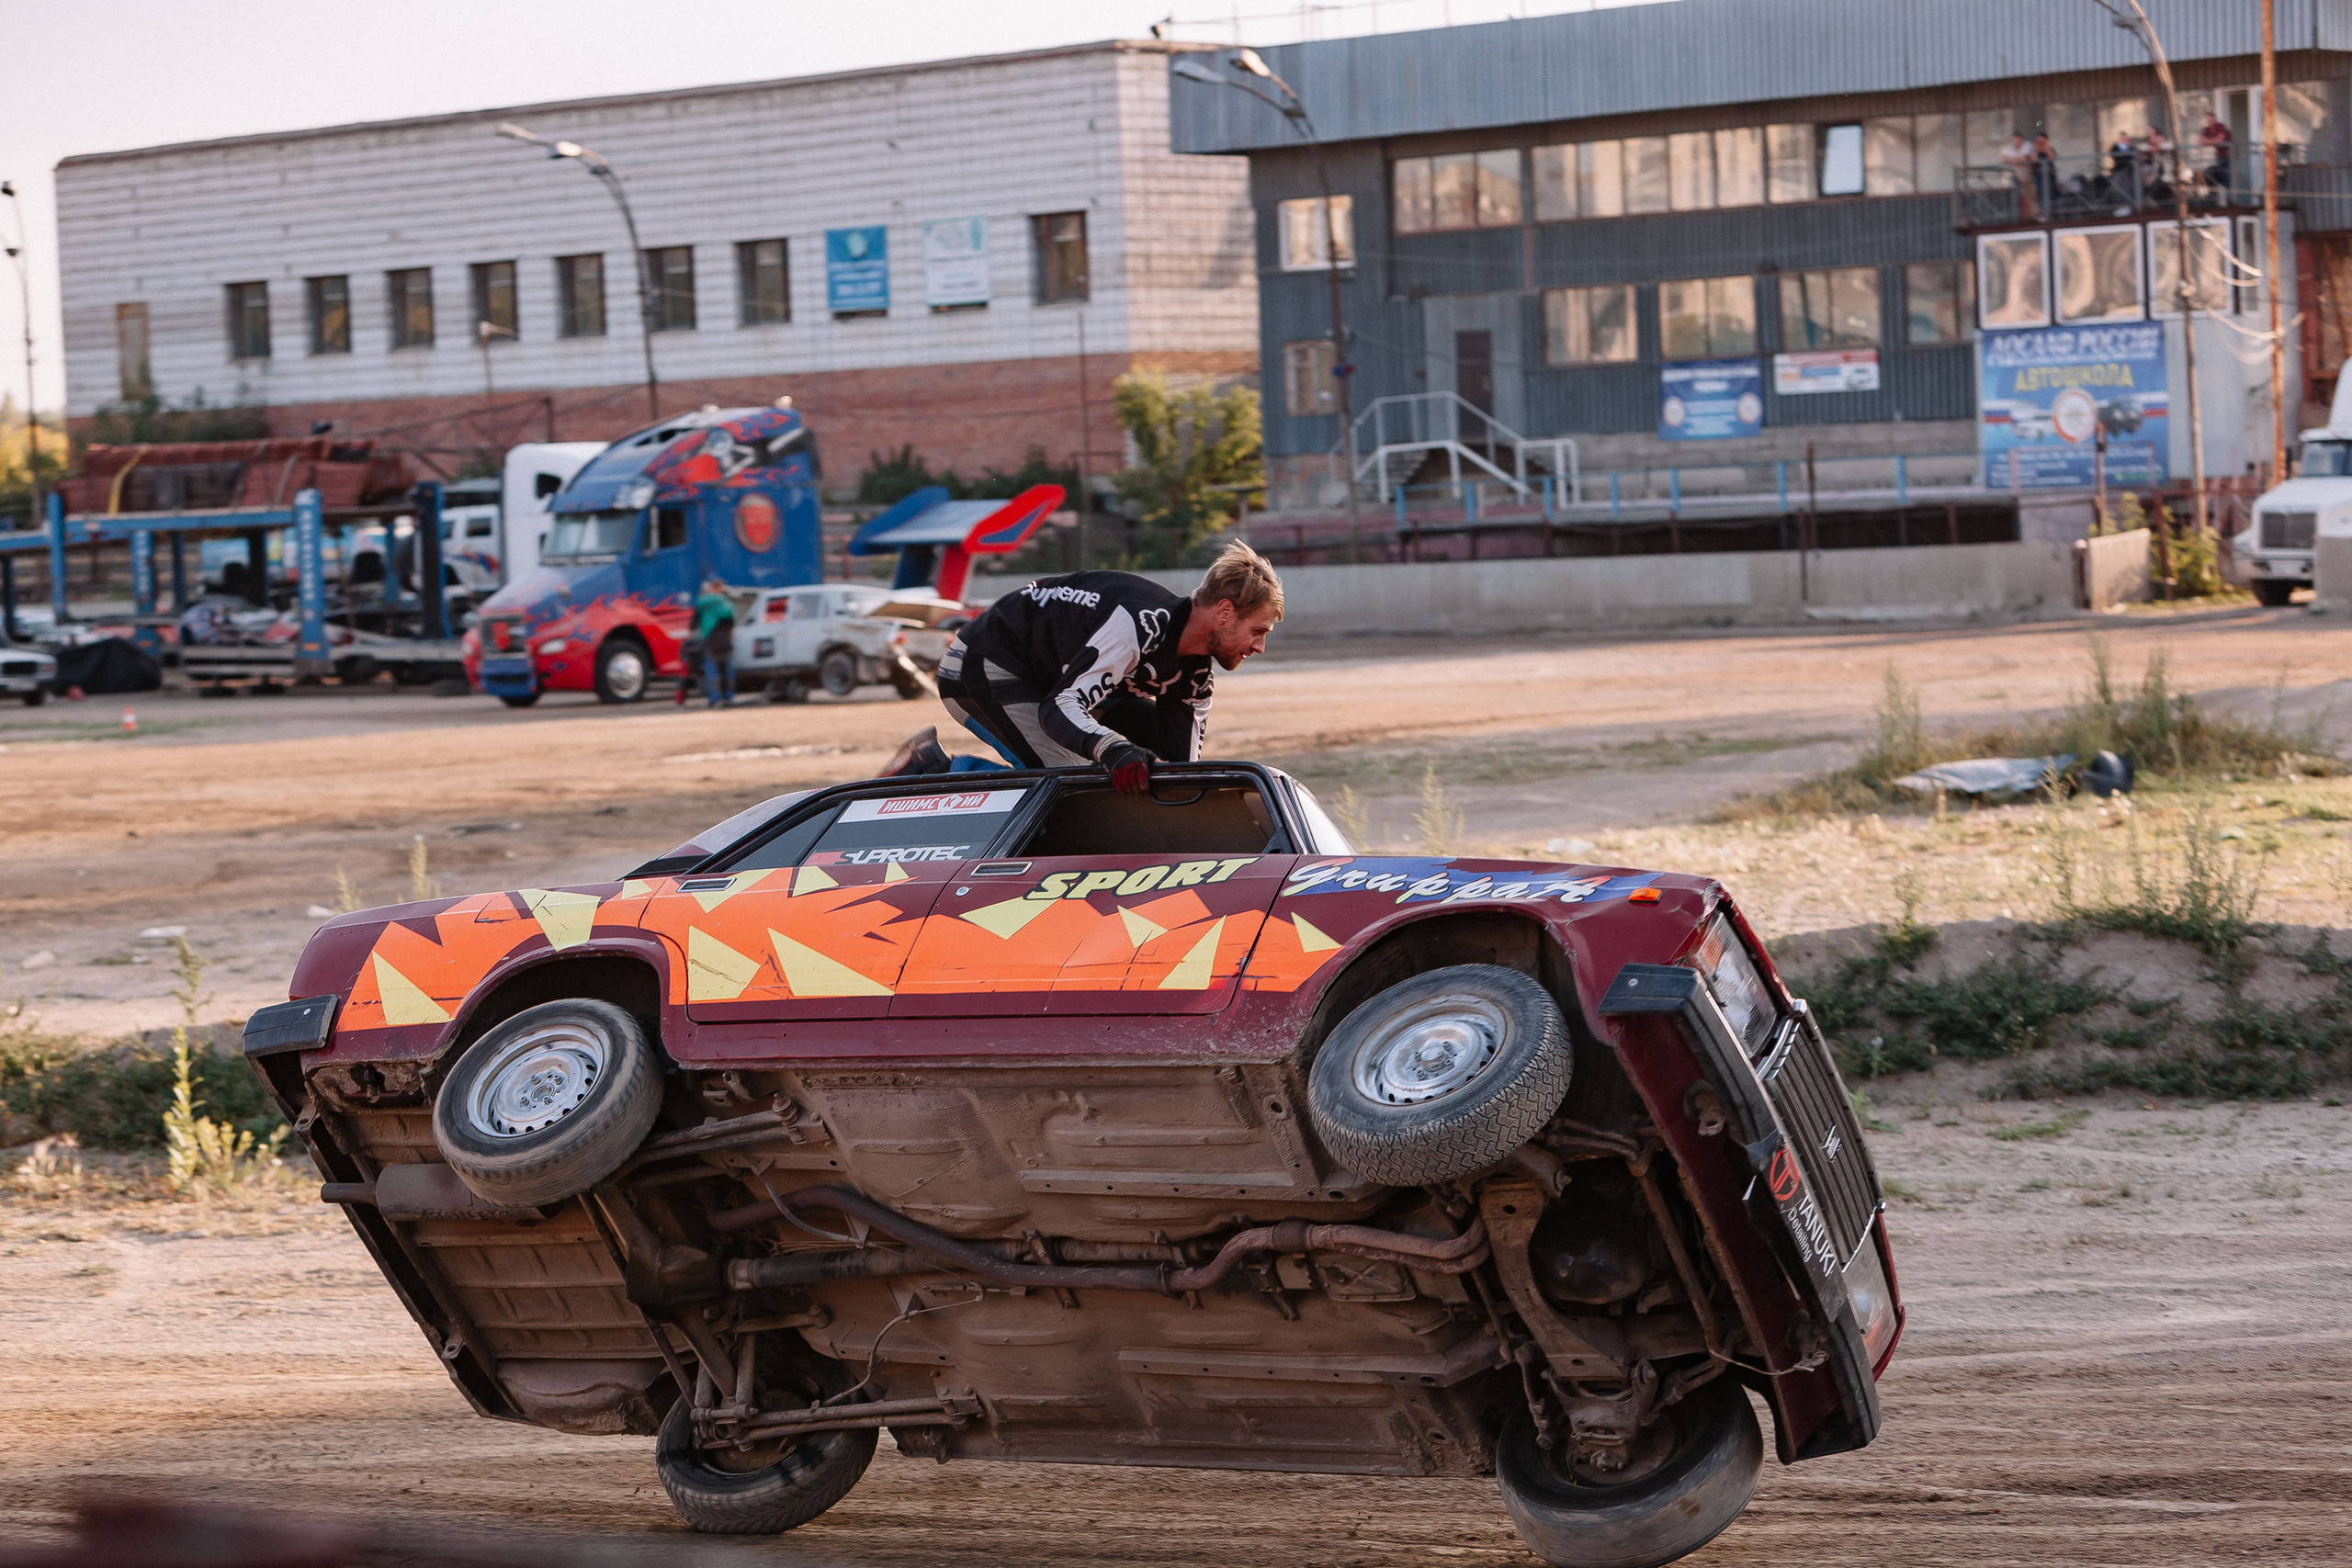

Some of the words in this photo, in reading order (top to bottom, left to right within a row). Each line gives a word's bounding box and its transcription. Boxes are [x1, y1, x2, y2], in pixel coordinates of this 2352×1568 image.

[2015, 364, 2133, 391] АВТОШКОЛА
[882, 794, 985, 813] ИШИМСКИЙ
[1025, 856, 1260, 899] SPORT
[1787, 1206, 1813, 1263] Detailing
[1798, 1192, 1837, 1277] TANUKI
